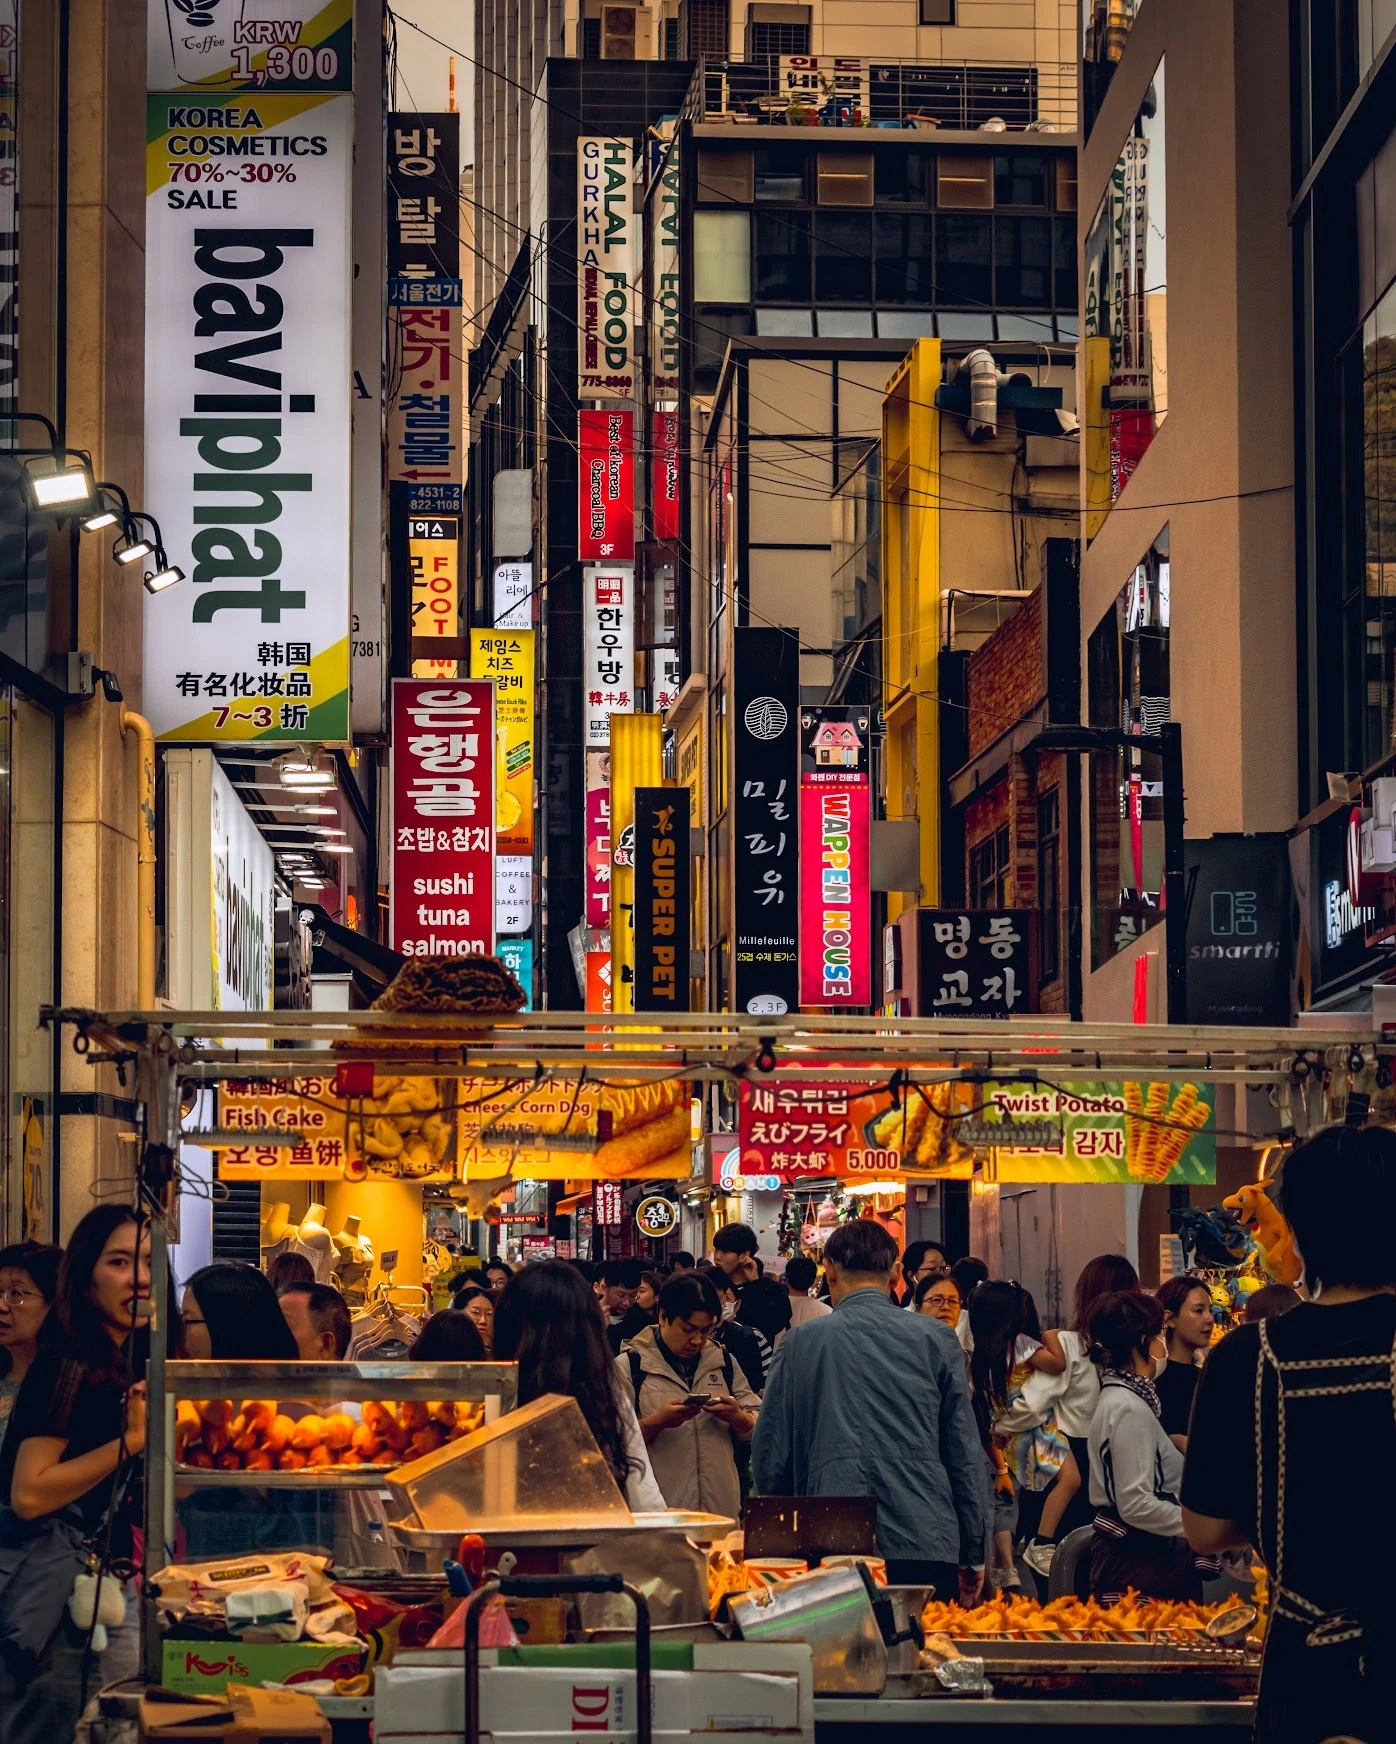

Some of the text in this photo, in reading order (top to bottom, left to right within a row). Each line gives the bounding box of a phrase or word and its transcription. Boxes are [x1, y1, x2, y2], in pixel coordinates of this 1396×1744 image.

[181, 35, 225, 54] Coffee
[233, 21, 302, 44] KRW
[230, 45, 338, 87] 1,300
[168, 108, 263, 128] KOREA
[168, 135, 328, 156] COSMETICS
[168, 163, 297, 183] 70%~30%
[168, 190, 238, 209] SALE
[582, 141, 600, 266] GURKHA
[604, 142, 627, 253] HALAL
[392, 284, 459, 302] 서울전기
[604, 272, 628, 371] FOOD
[180, 229, 316, 623] baviphat
[609, 415, 622, 443] Best
[590, 459, 605, 540] Charcoal BBQ
[600, 543, 614, 556] 3F
[430, 556, 452, 635] FOOT
[597, 578, 621, 590] 明洞
[257, 642, 311, 667] 韩国
[480, 639, 522, 655] 제임스
[596, 607, 623, 685] 한우방
[487, 657, 515, 670] 치즈
[175, 672, 312, 697] 有名化妆品
[212, 703, 310, 730] 7~3 折
[406, 690, 481, 817] 은행골
[396, 826, 491, 853] 초밥&참치
[821, 792, 851, 904] WAPPEN
[413, 872, 474, 895] sushi
[508, 883, 517, 894] &
[416, 904, 471, 926] tuna
[506, 916, 519, 925] 2F
[652, 838, 675, 1000] SUPER PET
[401, 934, 485, 957] salmon
[739, 936, 795, 945] Millefeuille
[933, 915, 1021, 960] 명동
[822, 909, 852, 997] HOUSE
[932, 966, 1022, 1009] 교자
[463, 1101, 590, 1115] Cheese Corn Dog
[751, 1088, 848, 1115] 새우튀김
[994, 1093, 1125, 1113] Twist Potato
[225, 1108, 324, 1126] Fish Cake
[749, 1121, 849, 1146] えびフライ
[1074, 1130, 1124, 1156] 감자
[771, 1151, 828, 1171] 炸大虾
[848, 1150, 900, 1171] 5,000
